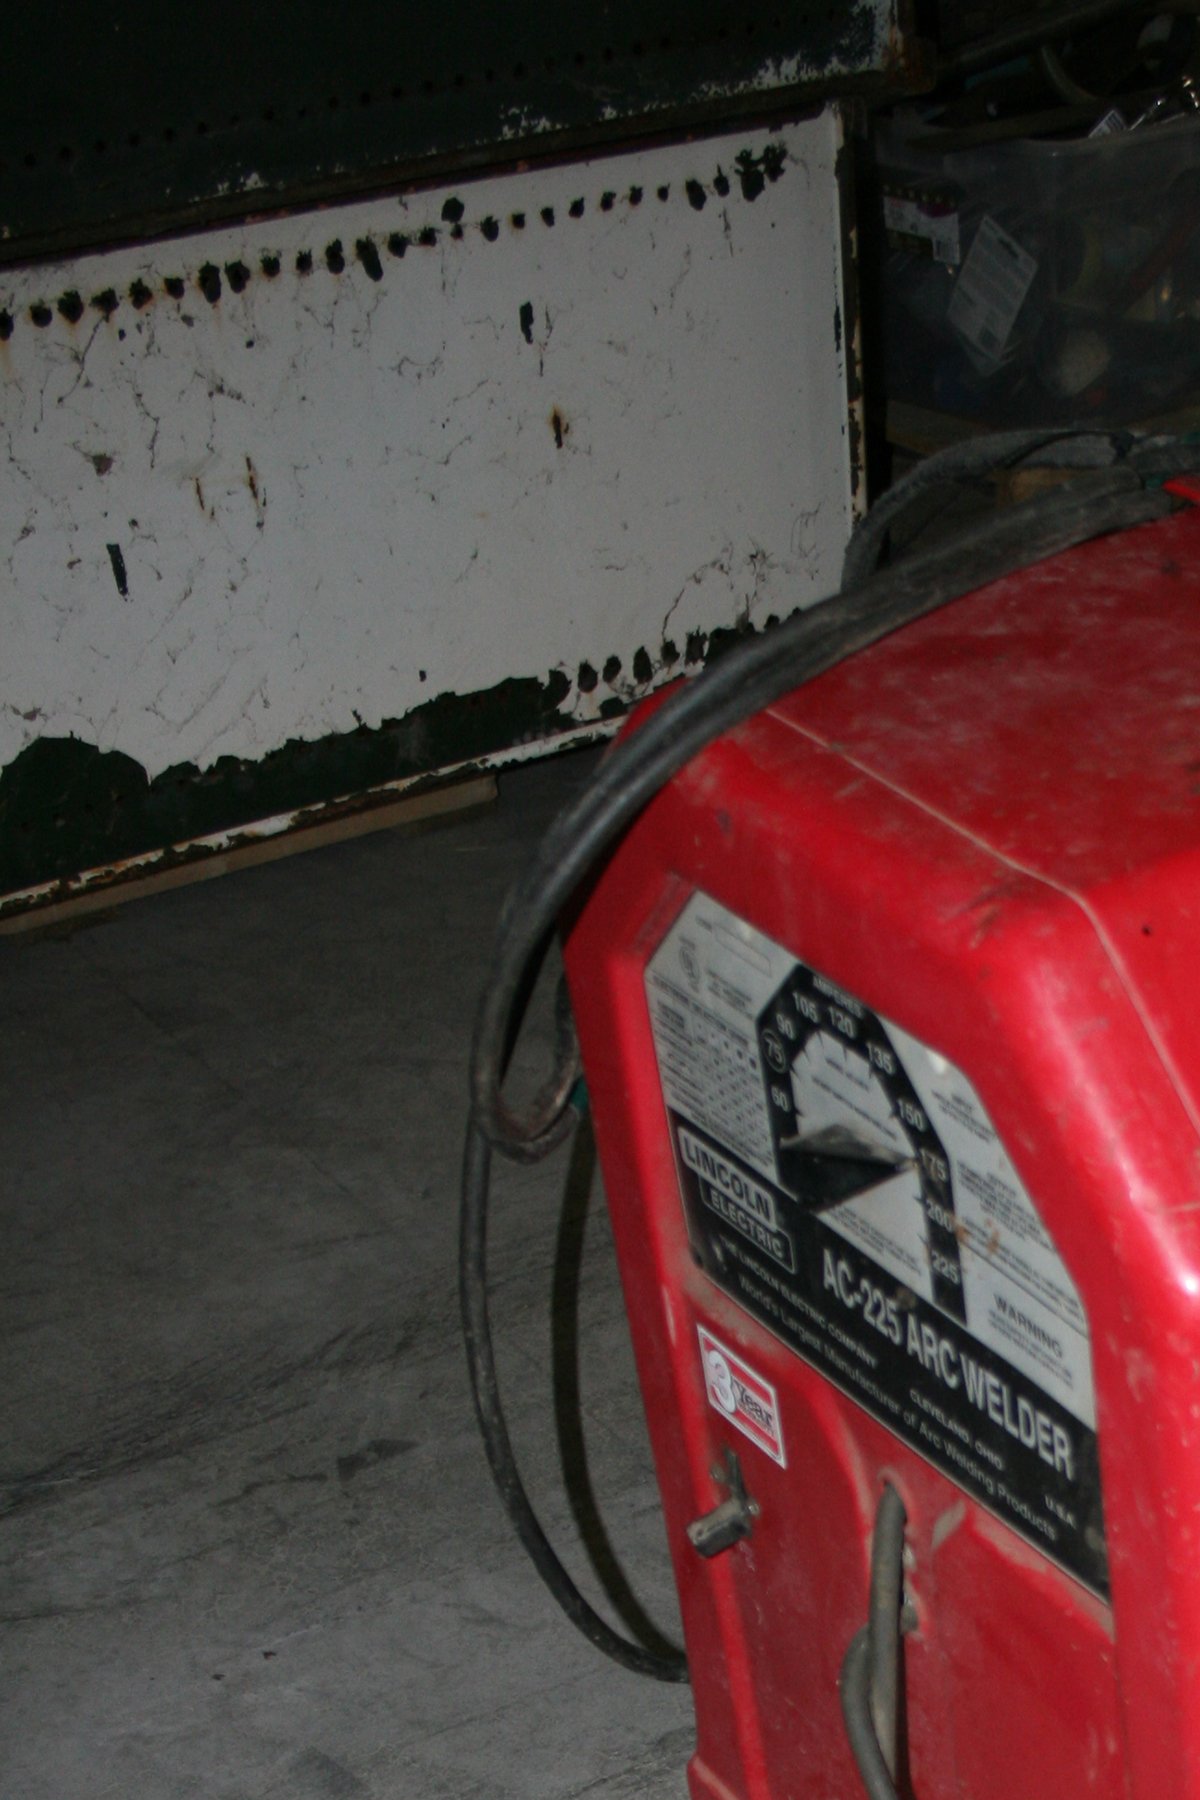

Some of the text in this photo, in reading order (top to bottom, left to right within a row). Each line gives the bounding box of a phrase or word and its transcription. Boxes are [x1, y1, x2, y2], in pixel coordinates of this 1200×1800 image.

[792, 991, 819, 1024] 105
[828, 1005, 857, 1039] 120
[776, 1013, 796, 1041] 90
[764, 1036, 784, 1065] 75
[866, 1041, 897, 1076] 135
[898, 1098, 925, 1132] 150
[683, 1136, 772, 1222] LINCOLN
[919, 1147, 947, 1181] 175
[710, 1187, 784, 1258] ELECTRIC
[926, 1199, 954, 1232] 200
[931, 1250, 960, 1284] 225
[994, 1293, 1063, 1358] WARNING
[739, 1251, 780, 1290] LINCOLN
[780, 1285, 826, 1329] ELECTRIC
[828, 1323, 877, 1368] COMPANY
[975, 1439, 1003, 1469] OHIO
[823, 1248, 901, 1345] AC-225
[906, 1313, 960, 1389] ARC
[961, 1353, 1074, 1481] WELDER
[707, 1349, 737, 1413] 3
[732, 1378, 773, 1427] Year
[781, 1308, 821, 1352] Largest
[824, 1343, 899, 1414] Manufacturer
[903, 1411, 916, 1427] of
[919, 1421, 941, 1448] Arc
[943, 1439, 994, 1495] Welding
[998, 1483, 1056, 1540] Products
